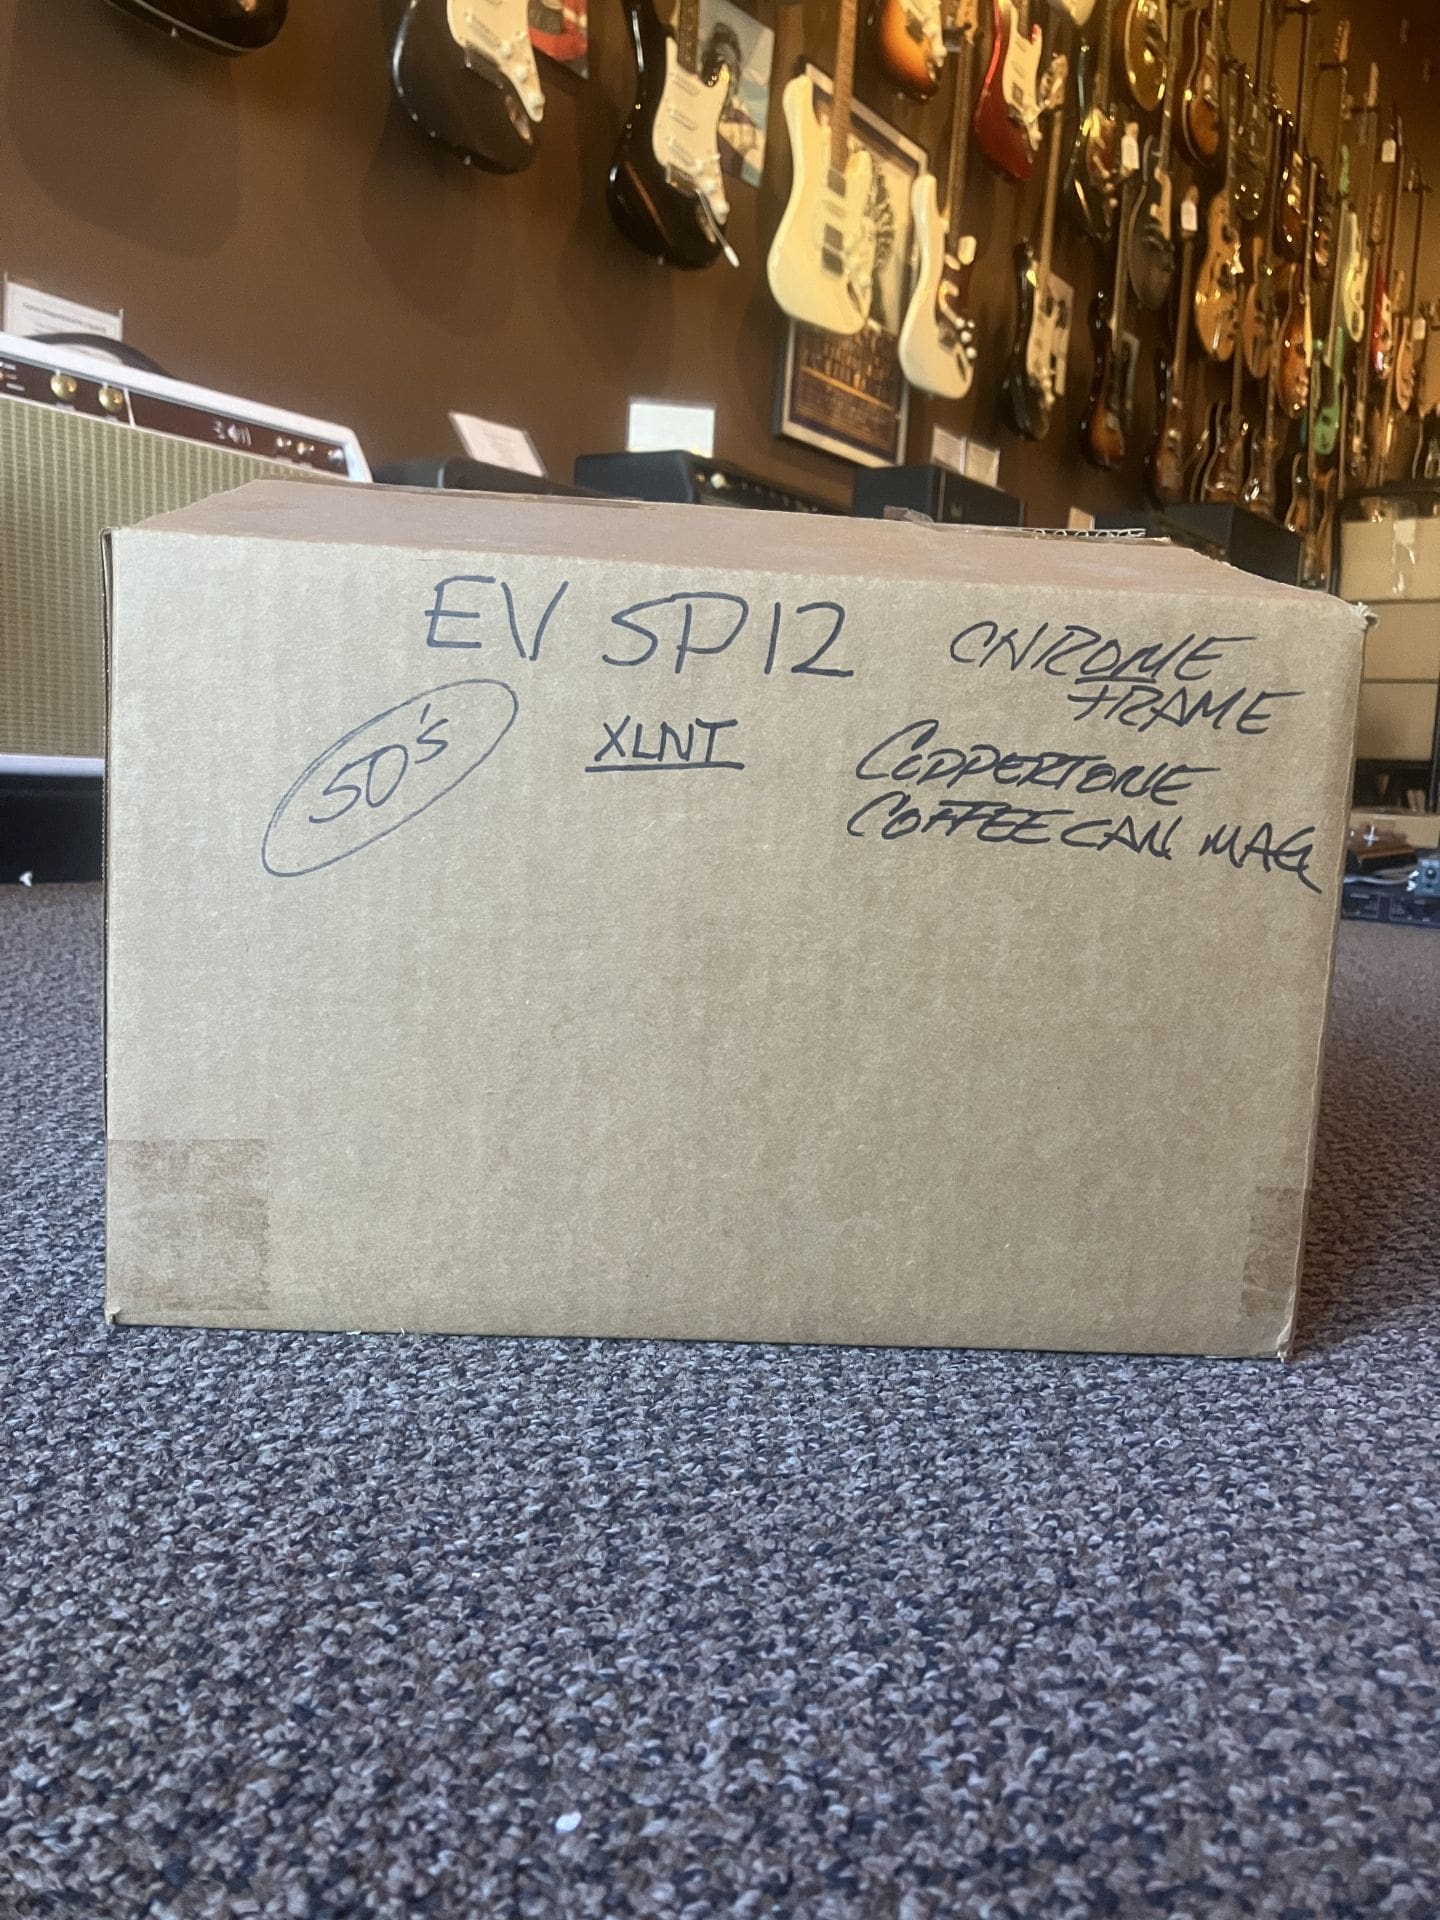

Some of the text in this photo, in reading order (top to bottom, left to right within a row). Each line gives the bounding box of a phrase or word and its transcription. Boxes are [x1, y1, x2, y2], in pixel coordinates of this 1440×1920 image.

[424, 574, 855, 676] EV SP12
[593, 714, 738, 763] XLNT
